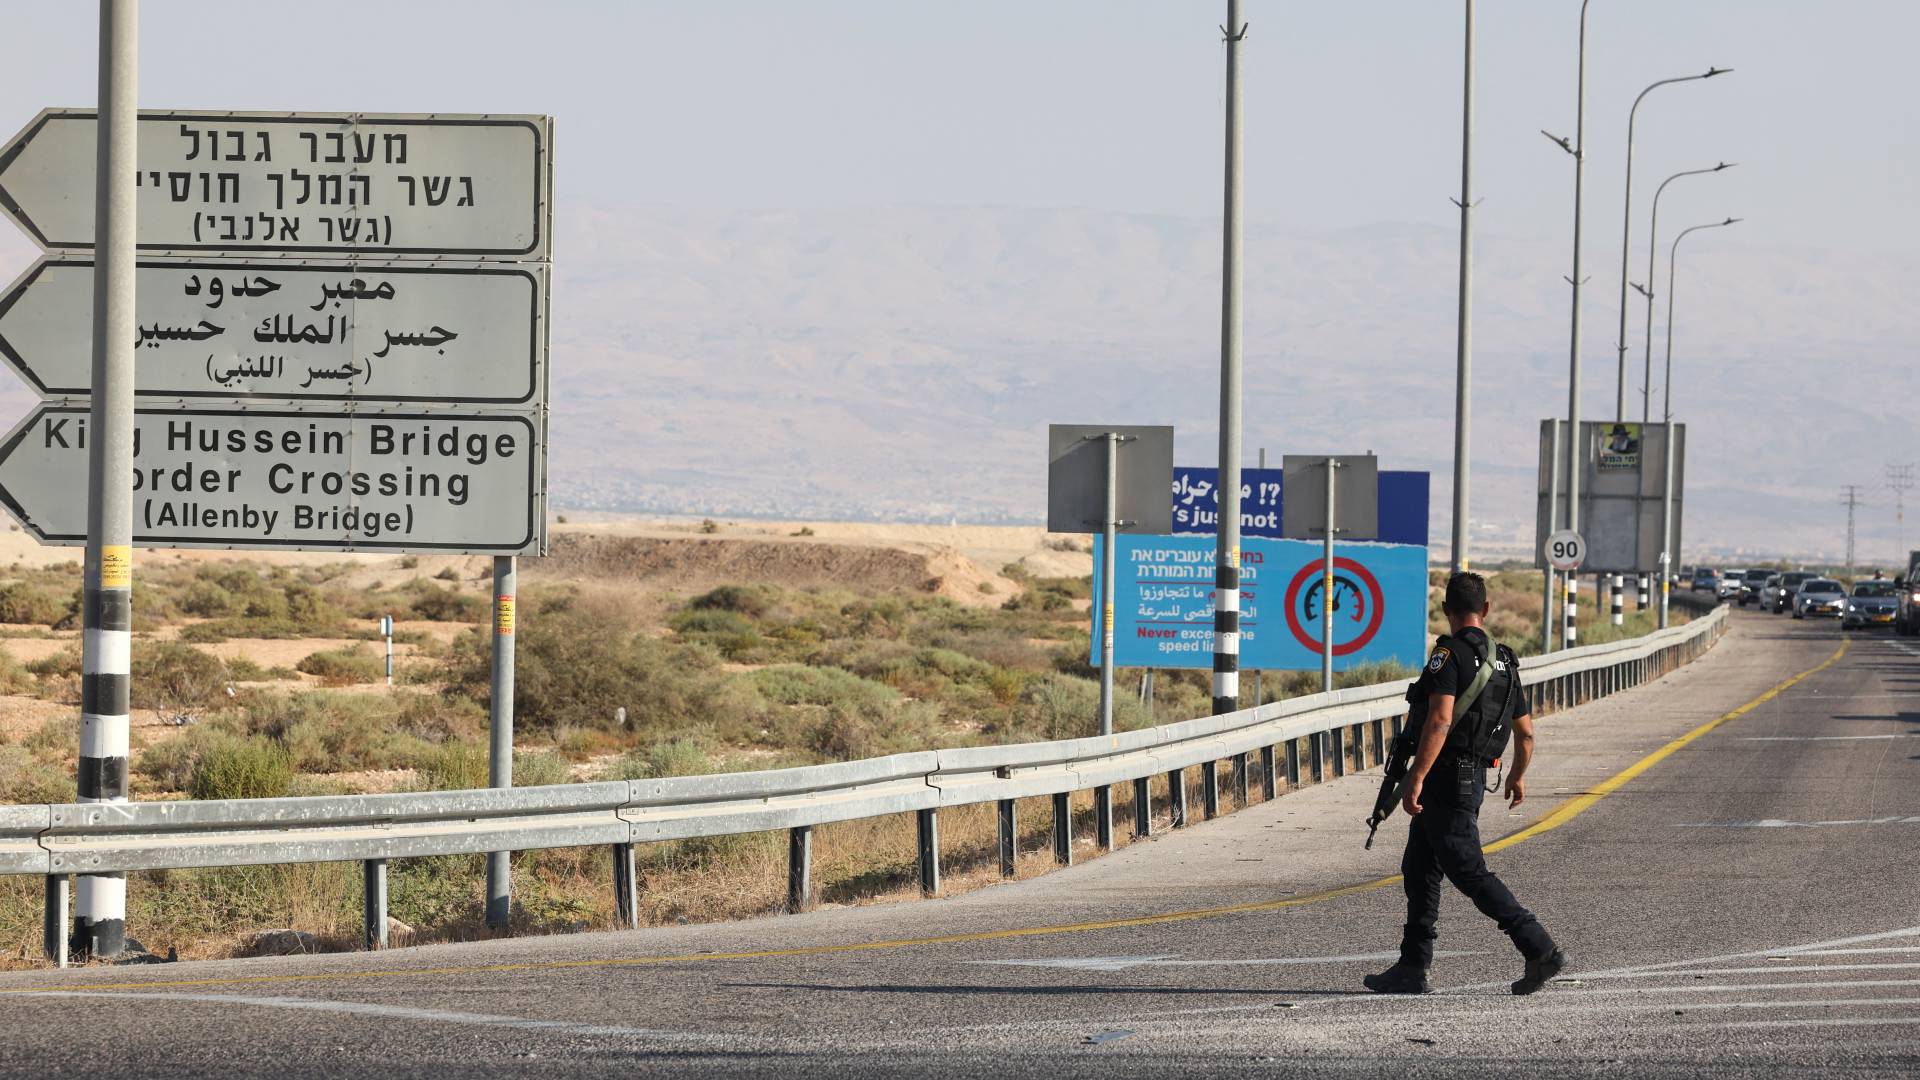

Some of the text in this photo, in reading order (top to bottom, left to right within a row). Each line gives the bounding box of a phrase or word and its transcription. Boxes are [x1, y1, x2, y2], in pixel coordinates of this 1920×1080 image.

[181, 124, 407, 164] מעבר גבול
[136, 168, 474, 210] גשר המלך חוסיי
[194, 211, 392, 246] (גשר אלנבי)
[185, 274, 396, 311] معبر حدود
[253, 314, 347, 345] الملك
[373, 326, 458, 358] جسر
[206, 355, 372, 389] (جسر اللنبي)
[168, 421, 343, 454] Hussein
[371, 424, 516, 465] Bridge
[133, 461, 470, 505] order Crossing
[145, 499, 413, 537] (Allenby Bridge)
[1240, 512, 1278, 528] not
[1131, 549, 1153, 562] את
[1155, 549, 1202, 563] עוברים
[1553, 541, 1578, 558] 90
[1137, 564, 1195, 578] המותרת
[1193, 586, 1204, 598] ما
[1138, 603, 1180, 620] للسرعة
[1137, 627, 1255, 640] Never exce he
[1158, 640, 1200, 653] speed
